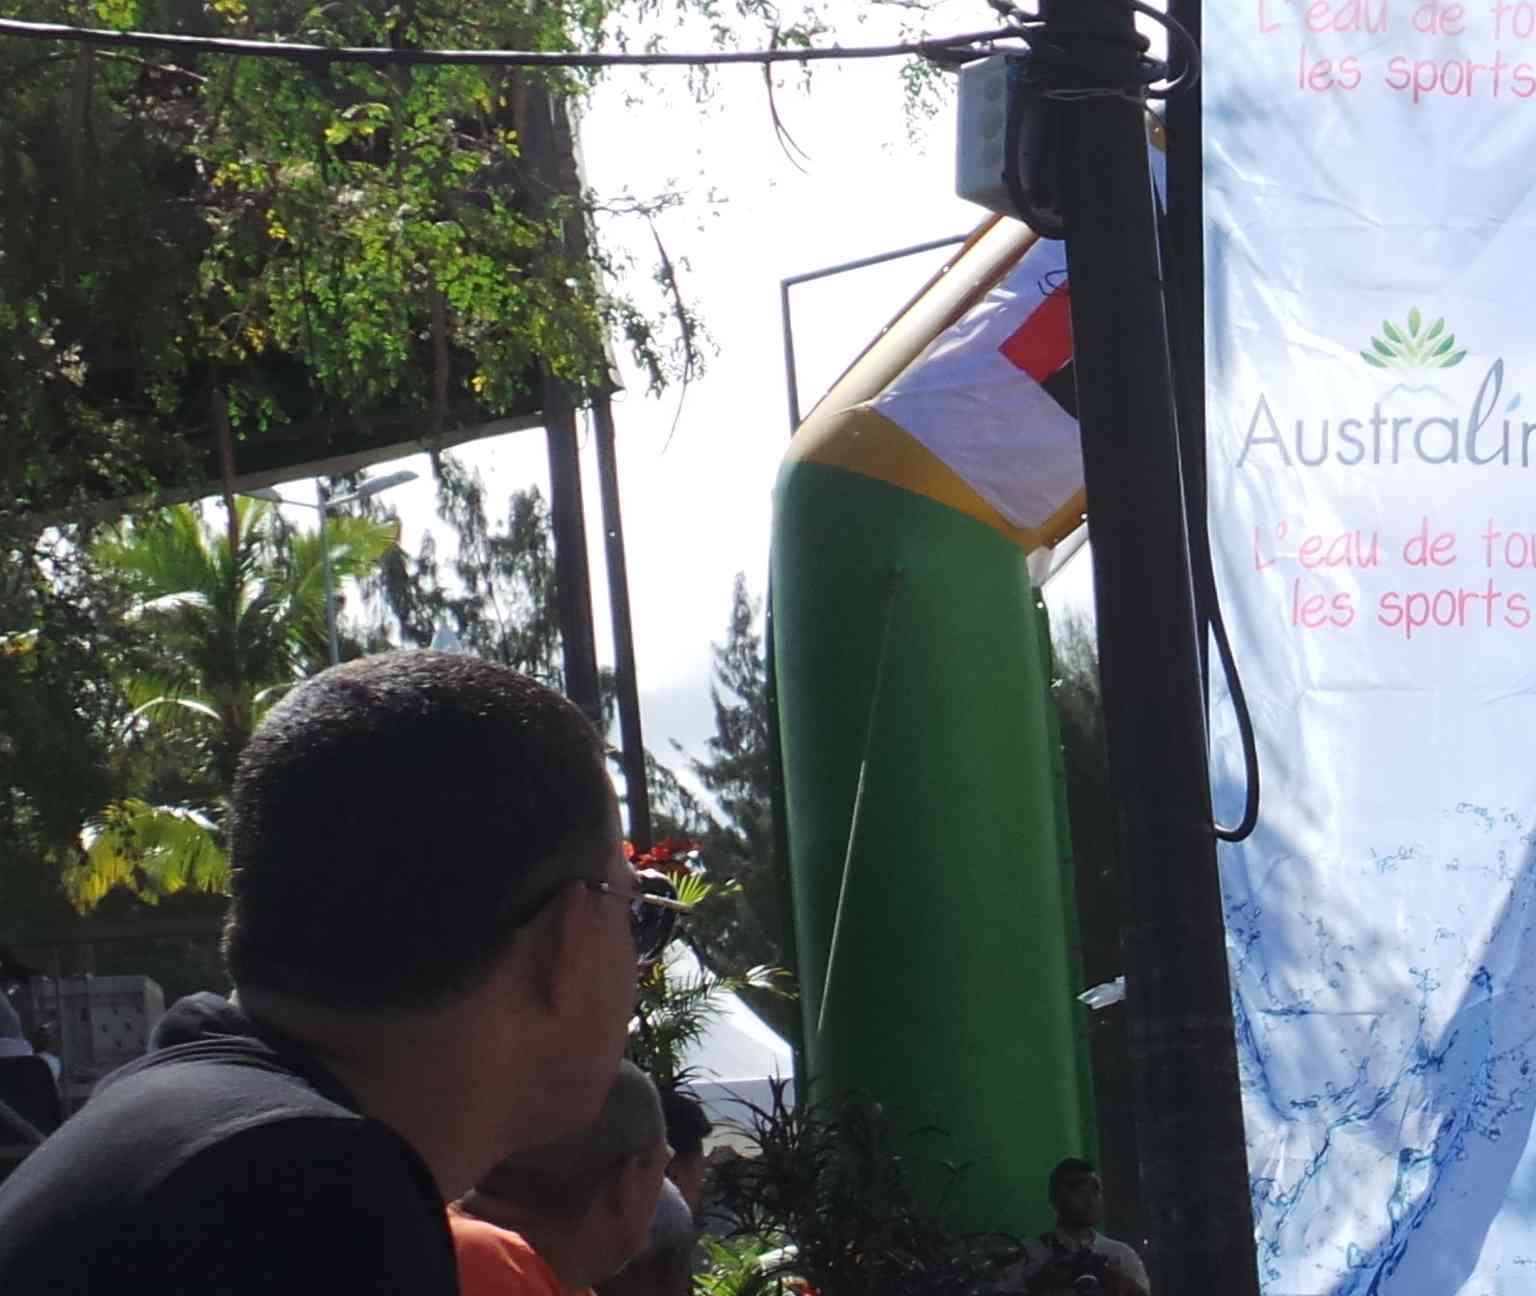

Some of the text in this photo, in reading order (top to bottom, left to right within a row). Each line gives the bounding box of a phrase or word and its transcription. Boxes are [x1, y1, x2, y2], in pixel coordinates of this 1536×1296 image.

[1258, 0, 1388, 33] Leau
[1412, 0, 1466, 36] de
[1299, 48, 1361, 91] les
[1253, 520, 1379, 572] L'eau
[1402, 516, 1457, 567] de
[1290, 578, 1356, 630] les
